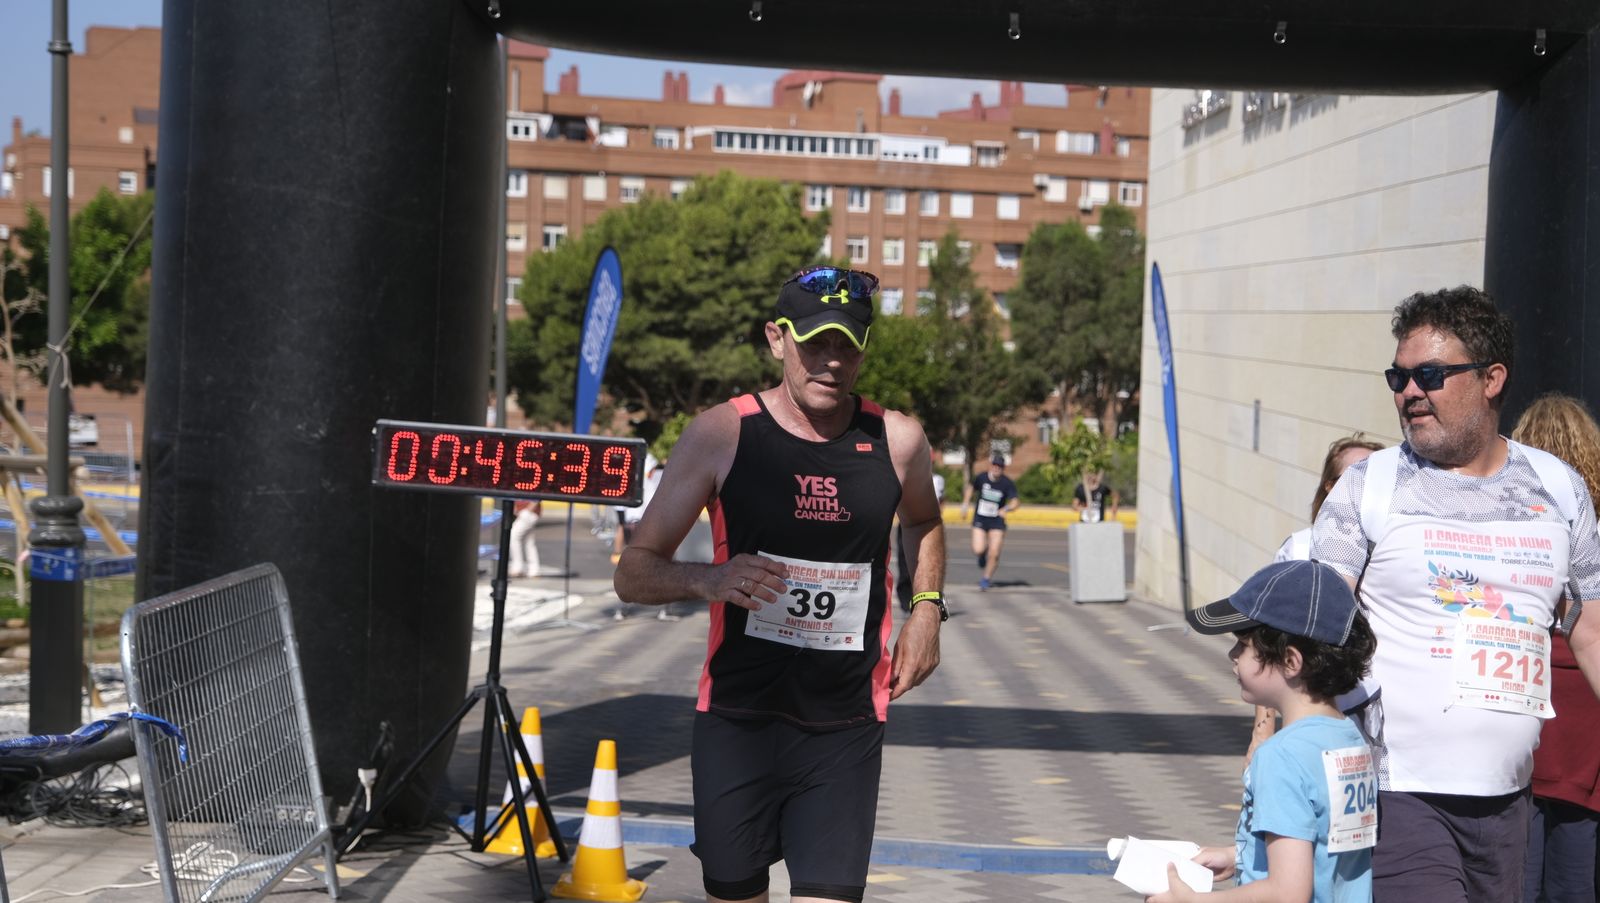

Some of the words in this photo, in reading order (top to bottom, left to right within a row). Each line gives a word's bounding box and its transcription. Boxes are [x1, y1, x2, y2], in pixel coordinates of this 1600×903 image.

[387, 430, 632, 497] 00:45:39
[794, 474, 838, 498] YES
[795, 494, 839, 512] WITH
[794, 509, 838, 522] CANCER
[1424, 529, 1433, 540] II
[1436, 530, 1492, 547] CARRERA
[1495, 536, 1517, 548] SIN
[1519, 537, 1553, 551] HUMO
[1435, 550, 1462, 558] MUNDIAL
[820, 569, 835, 579] SIN
[838, 570, 861, 580] HUMO
[1510, 573, 1517, 585] 4
[1522, 574, 1553, 588] JUNIO
[787, 588, 836, 620] 39
[785, 617, 821, 631] ANTONIO
[1475, 624, 1517, 639] CARRERA
[1518, 630, 1531, 641] SIN
[1470, 648, 1545, 687] 1212
[1343, 780, 1376, 816] 204
